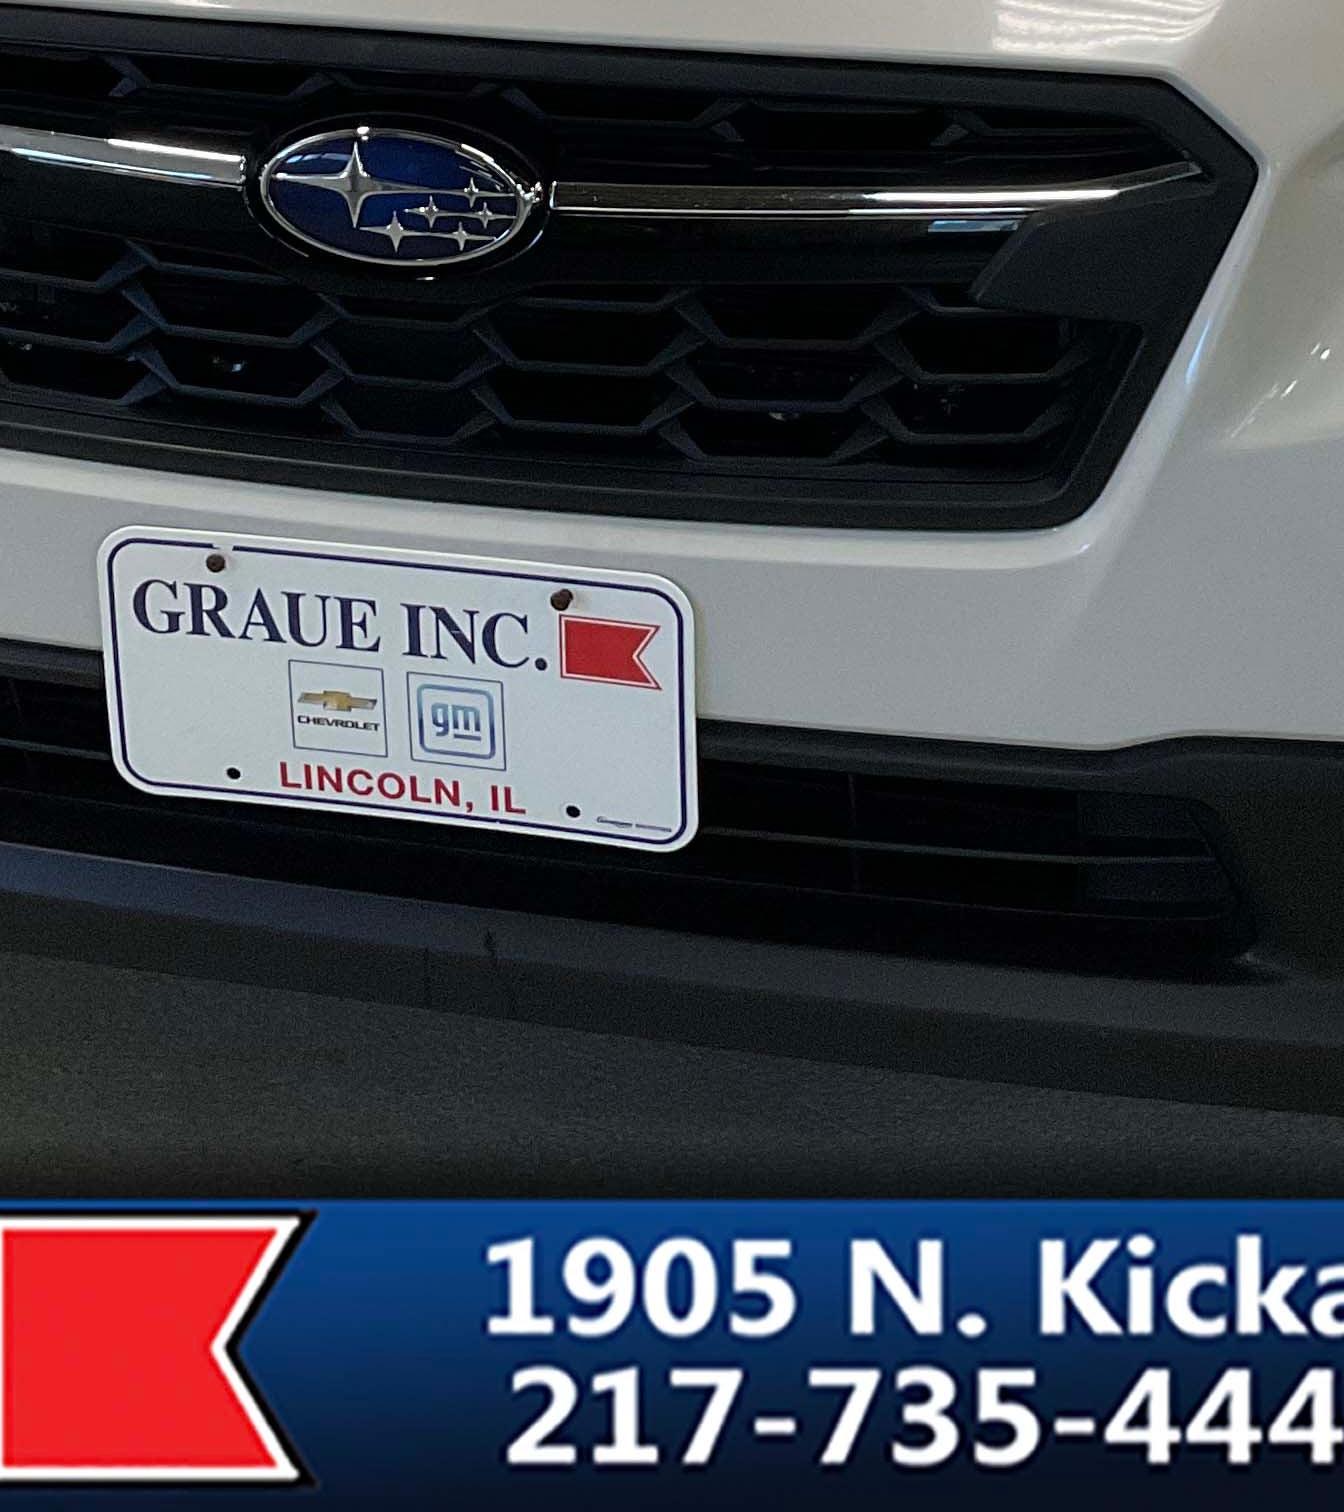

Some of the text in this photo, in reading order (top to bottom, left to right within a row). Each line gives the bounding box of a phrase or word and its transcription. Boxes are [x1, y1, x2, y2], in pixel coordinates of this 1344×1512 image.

[132, 578, 548, 671] GRAUE INC.
[297, 714, 381, 732] CHEVROLET
[430, 701, 482, 738] gm
[279, 760, 527, 815] LINCOLN, IL
